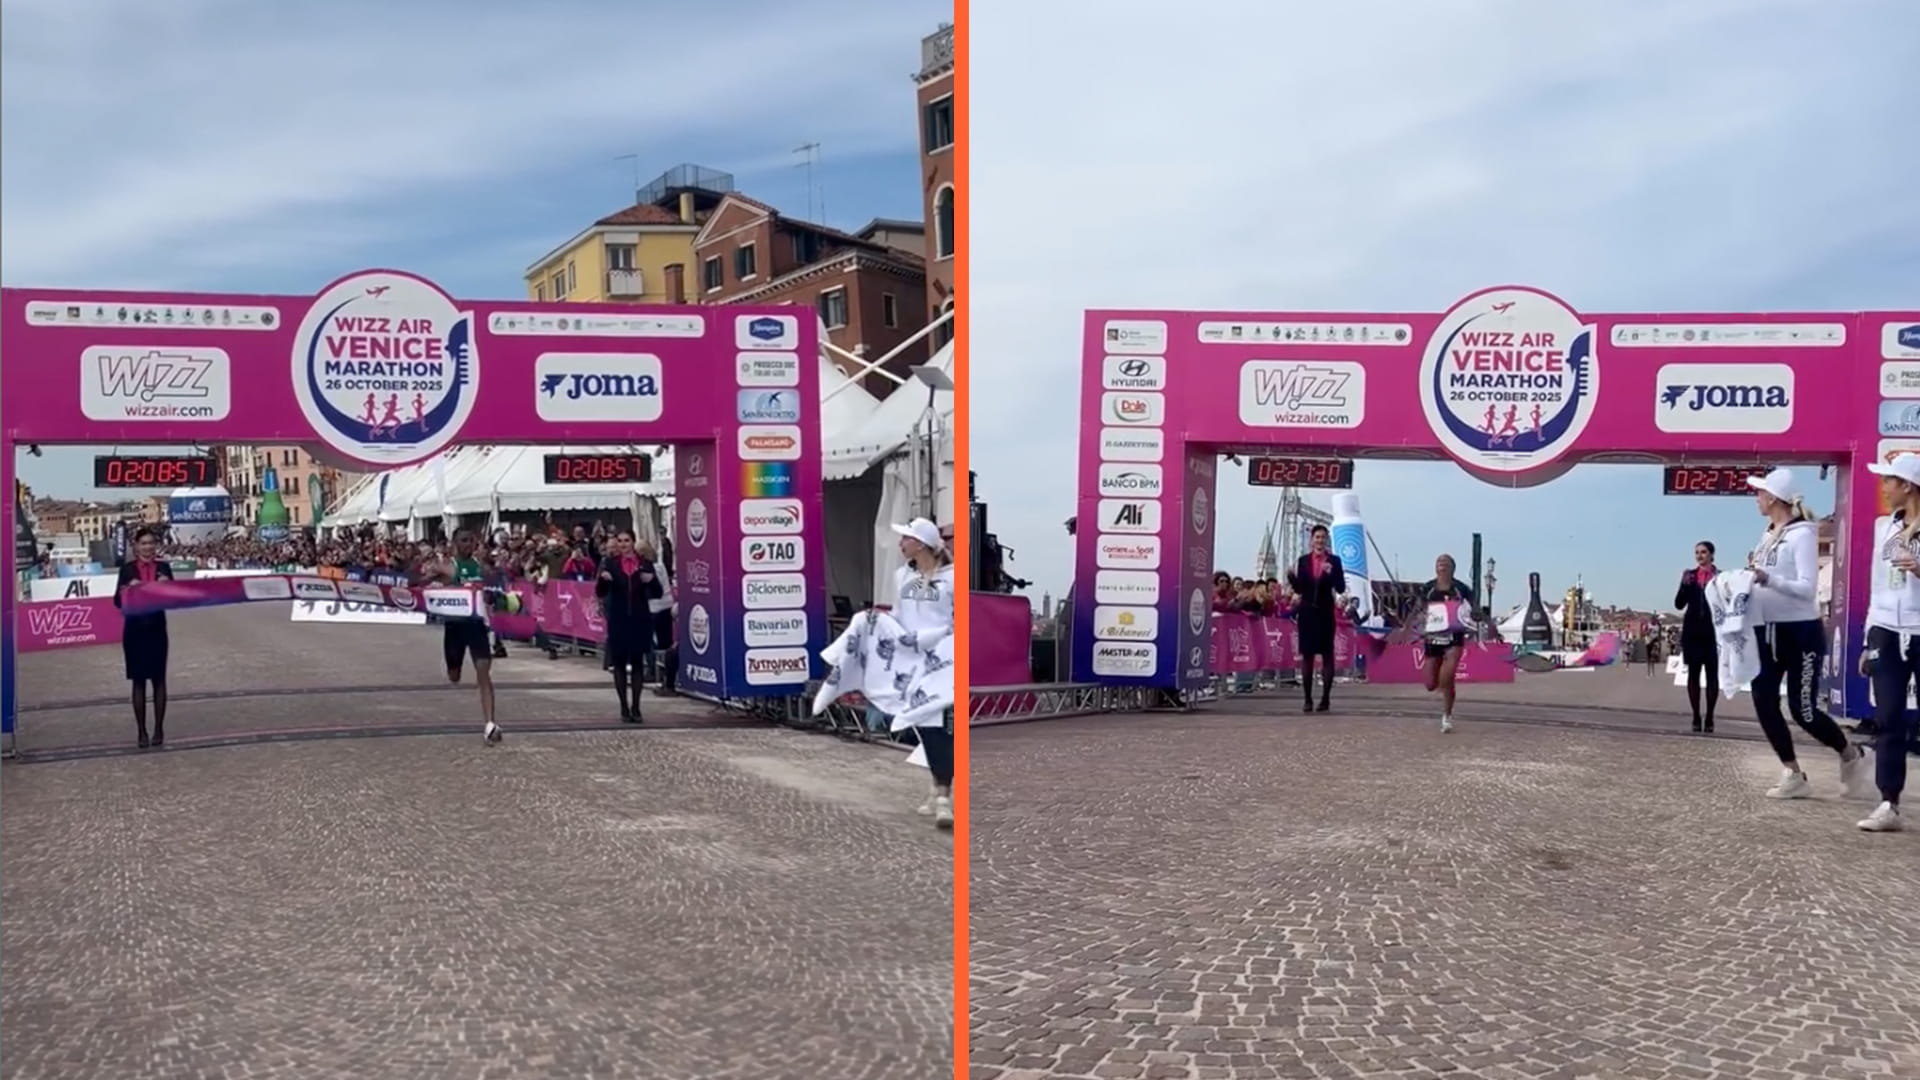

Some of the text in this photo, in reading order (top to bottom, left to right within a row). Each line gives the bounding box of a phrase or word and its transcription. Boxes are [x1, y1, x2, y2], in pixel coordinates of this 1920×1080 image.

[334, 317, 432, 334] WIZZ AIR
[1461, 332, 1554, 347] WIZZ AIR
[326, 336, 442, 359] VENICE
[1452, 350, 1563, 372] VENICE
[325, 361, 443, 377] MARATHON
[326, 380, 443, 391] 26 OCTOBER 2025
[1111, 378, 1157, 387] HYUNDAI
[1450, 374, 1562, 388] MARATHON
[1450, 391, 1562, 402] 26 OCTOBER 2025
[125, 403, 213, 418] wizzair.com
[1275, 412, 1349, 424] wizzair.com
[108, 461, 206, 483] 02:08:57
[558, 459, 642, 479] 02:08:57
[1259, 462, 1340, 483] 02:27:30
[1102, 478, 1159, 489] BANCO BPM
[1675, 471, 1765, 490] 02:27:3
[744, 515, 793, 527] deporvillage
[768, 543, 795, 560] TAO
[747, 583, 802, 594] Dicloreum
[748, 619, 790, 631] Bavaria
